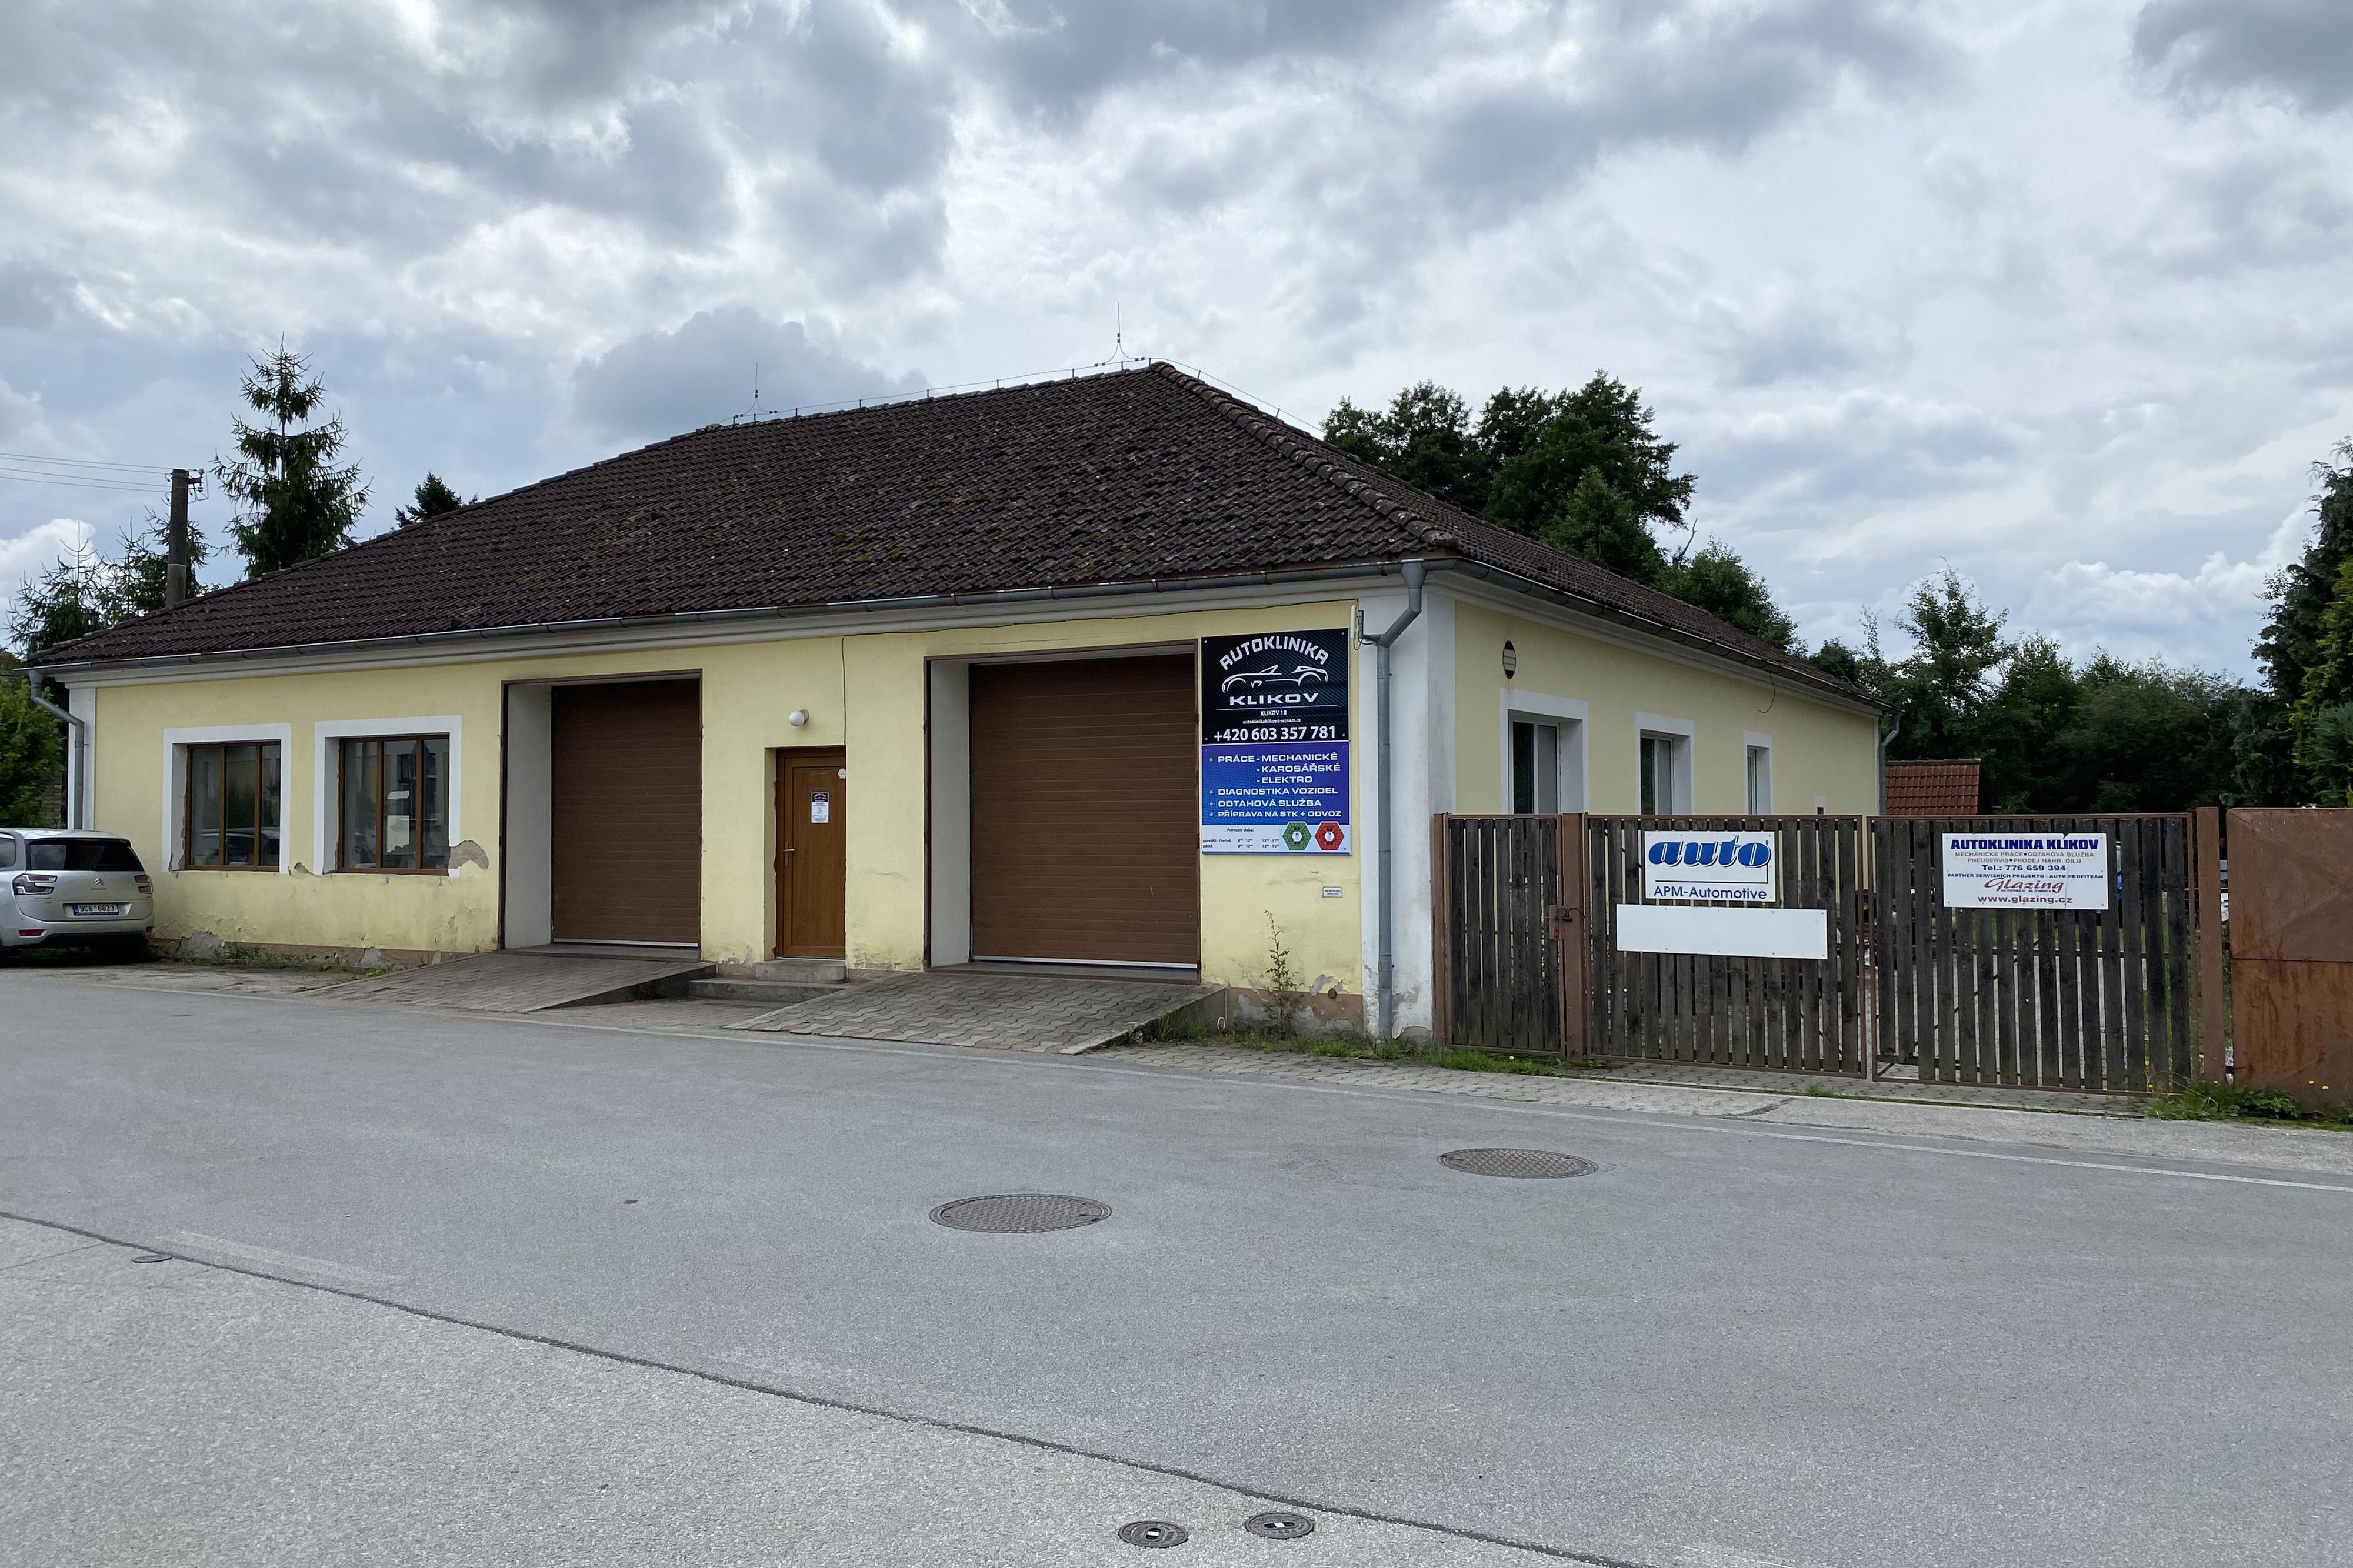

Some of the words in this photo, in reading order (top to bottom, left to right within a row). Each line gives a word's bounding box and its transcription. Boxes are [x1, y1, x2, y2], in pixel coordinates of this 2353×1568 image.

[1219, 636, 1329, 670] AUTOKLINIKA
[1229, 693, 1319, 706] KLIKOV
[1214, 728, 1248, 742] +420
[1251, 728, 1277, 740] 603
[1281, 726, 1307, 740] 357
[1310, 725, 1335, 739] 781
[1218, 754, 1255, 763] PRÁCE
[1261, 751, 1338, 762] MECHANICKÉ
[1261, 762, 1341, 773] KAROSÁŘSKÉ
[1218, 798, 1277, 807] ODTAHOVÁ
[1278, 798, 1322, 806] SLUŽBA
[1951, 839, 2044, 849] AUTOKLINIKA
[2046, 839, 2099, 849] KLIKOV
[1648, 835, 1771, 868] auto
[1654, 885, 1767, 899] APM-Automotive
[1977, 895, 2073, 905] www.glazing.cz
